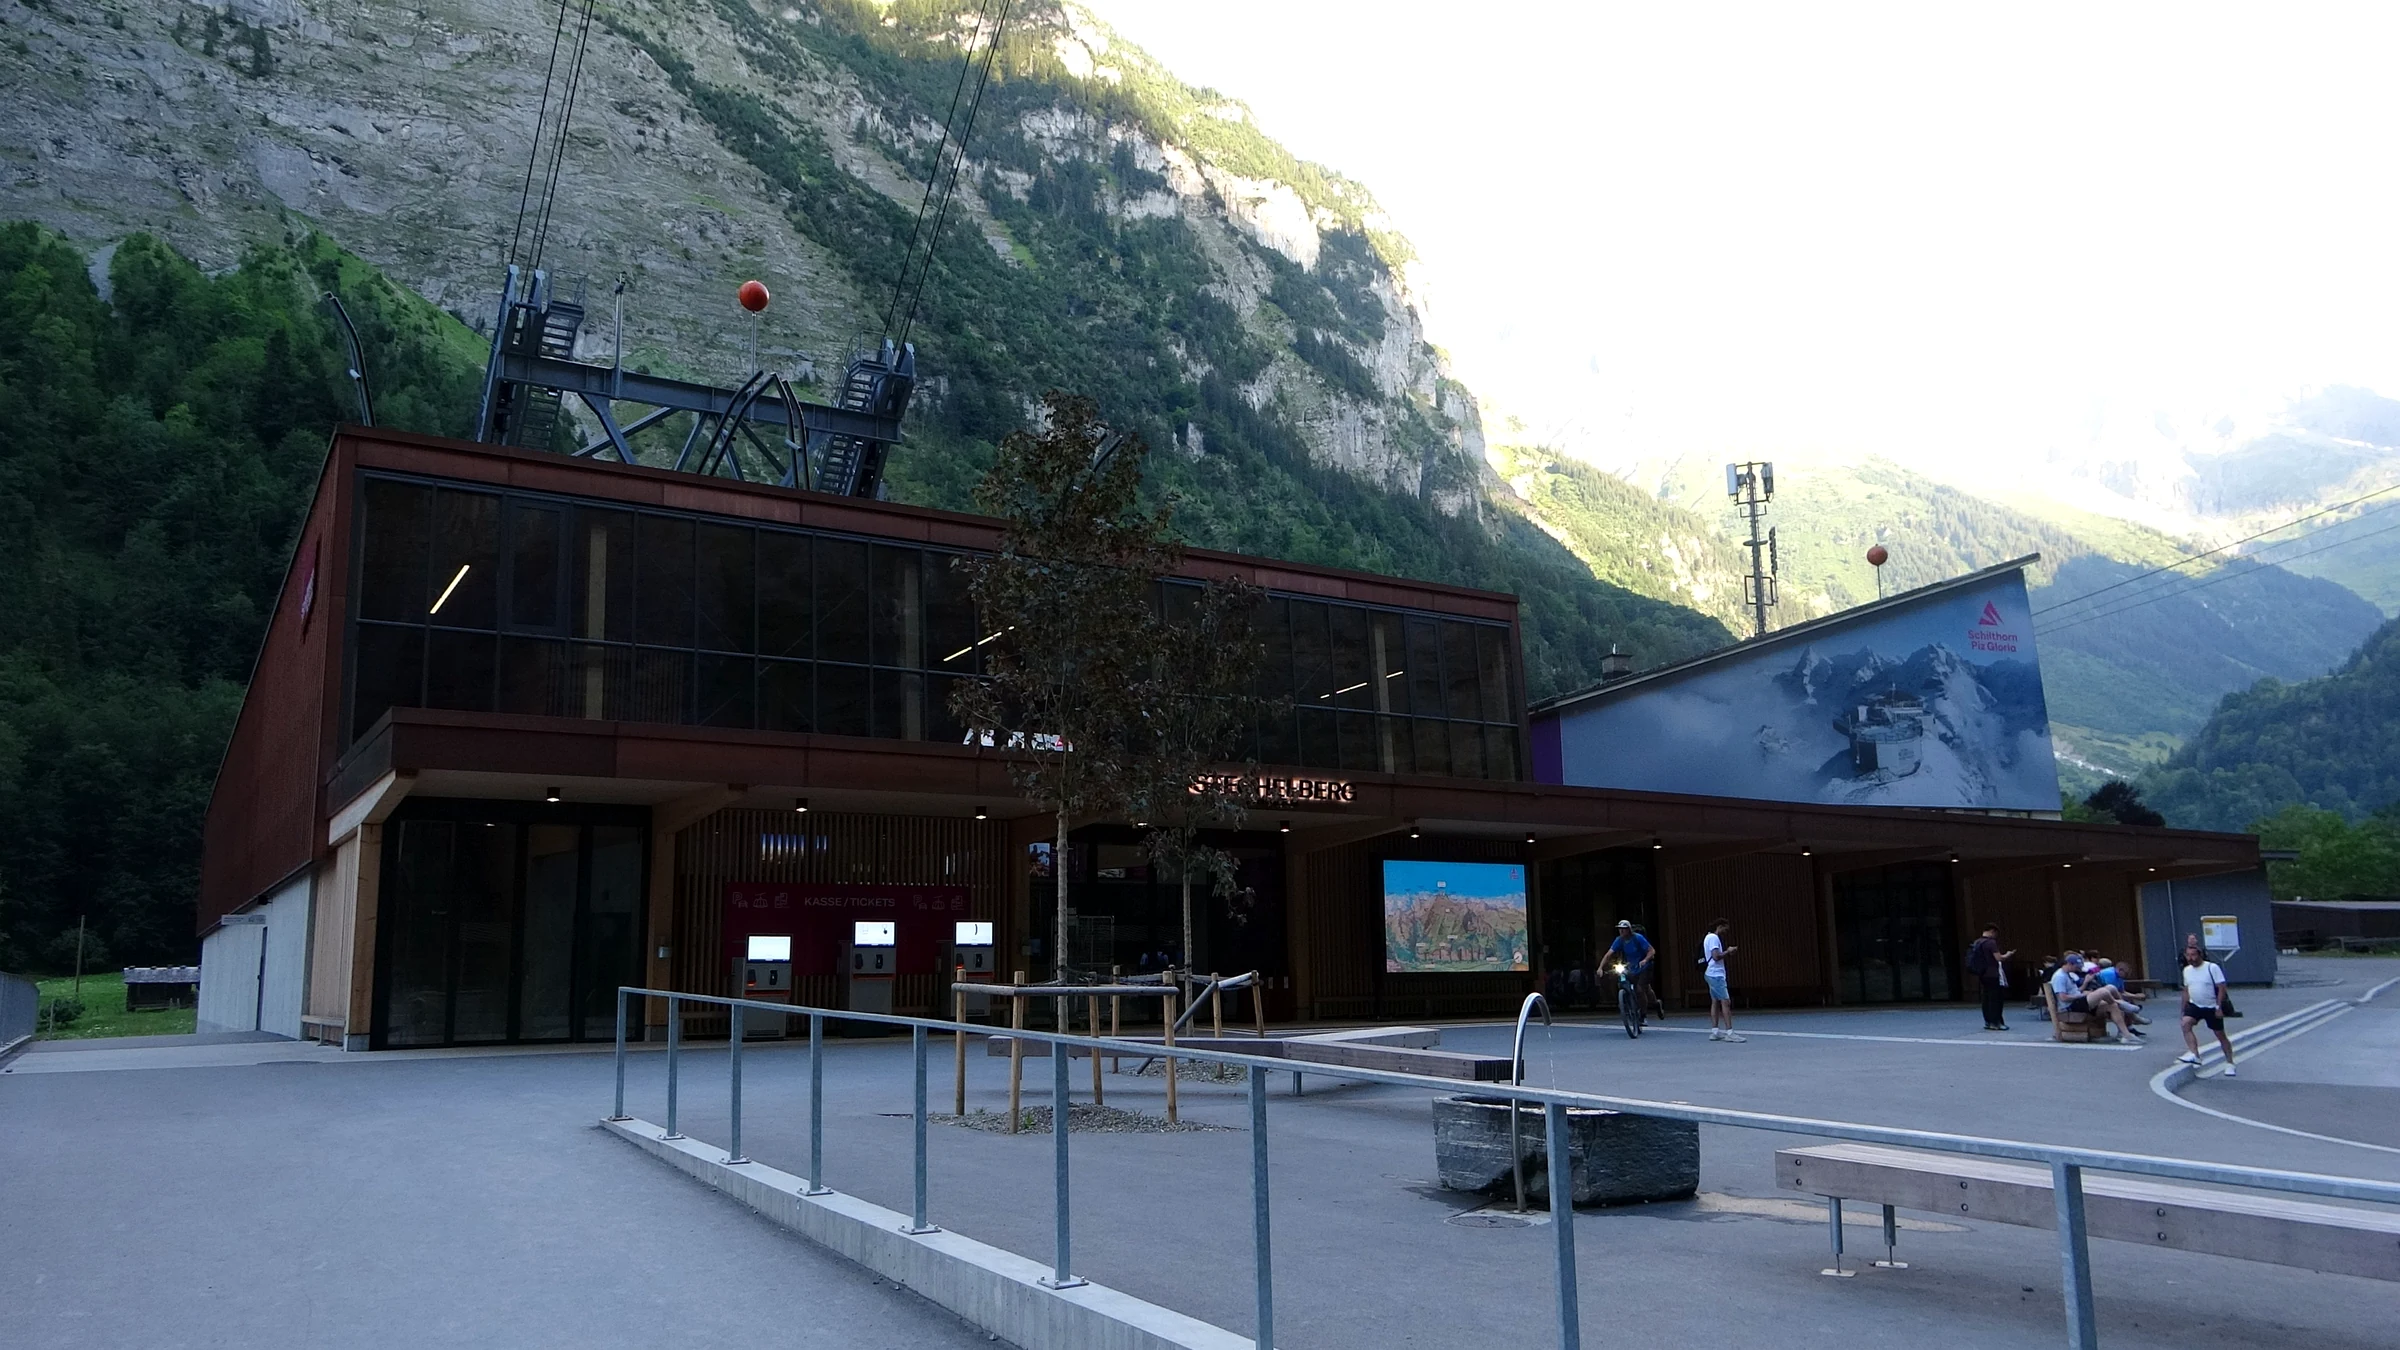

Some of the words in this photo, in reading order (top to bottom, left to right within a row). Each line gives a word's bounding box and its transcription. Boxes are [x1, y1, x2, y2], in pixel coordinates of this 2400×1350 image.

[1967, 630, 2018, 642] Schilthorn
[1971, 641, 1985, 651] Piz
[1986, 642, 2017, 653] Gloria
